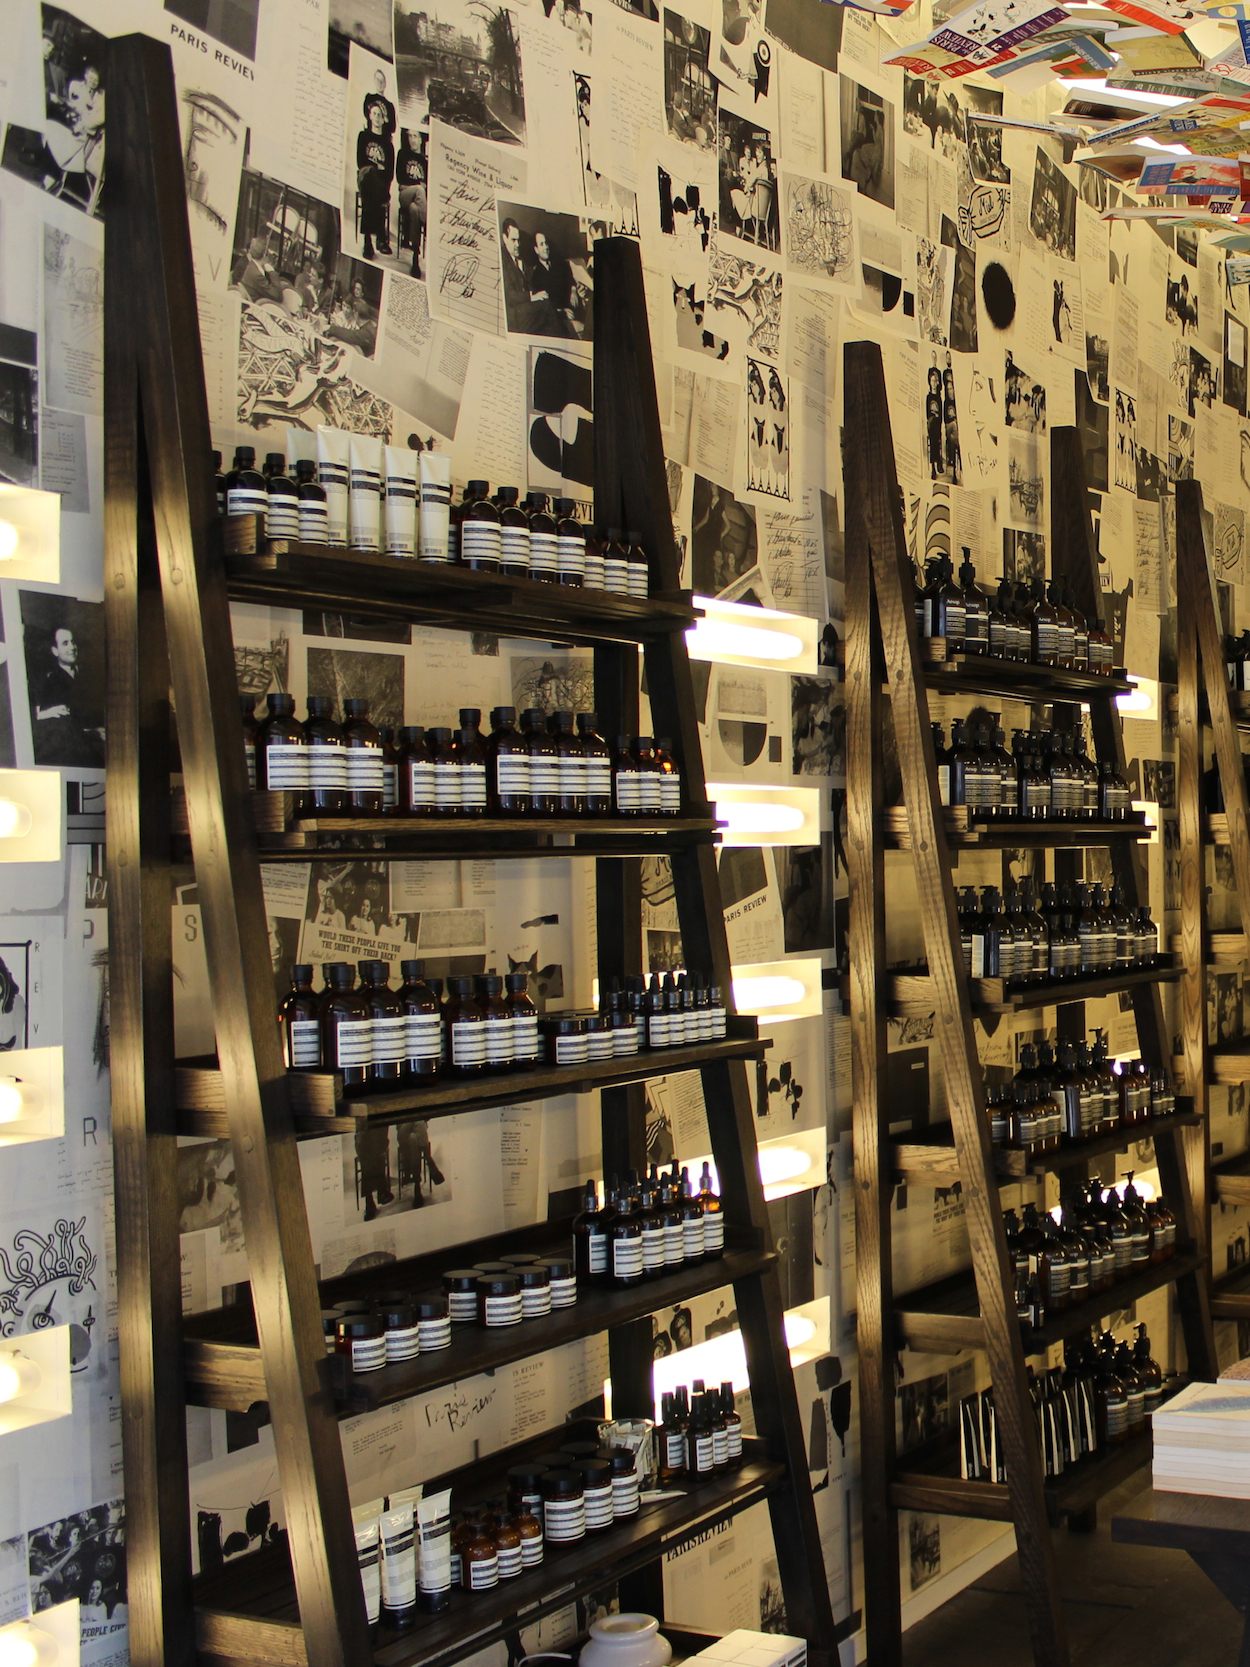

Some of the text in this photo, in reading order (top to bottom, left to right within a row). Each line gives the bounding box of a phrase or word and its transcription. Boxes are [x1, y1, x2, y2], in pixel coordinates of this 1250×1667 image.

[170, 23, 208, 53] PARIS
[931, 36, 960, 52] PARIS
[940, 31, 982, 53] REVIEW
[446, 154, 470, 172] Regency
[472, 166, 486, 178] Wine
[744, 894, 767, 913] REVIEW
[318, 930, 401, 953] WOULD THESE PEOPLE GIVE YOU
[322, 940, 397, 960] THE SHIRT OFF THEIR BACK?
[521, 1362, 545, 1374] REVIEW
[424, 1392, 468, 1428] Paris
[448, 1389, 497, 1432] Review
[81, 1625, 108, 1638] PEOPLE
